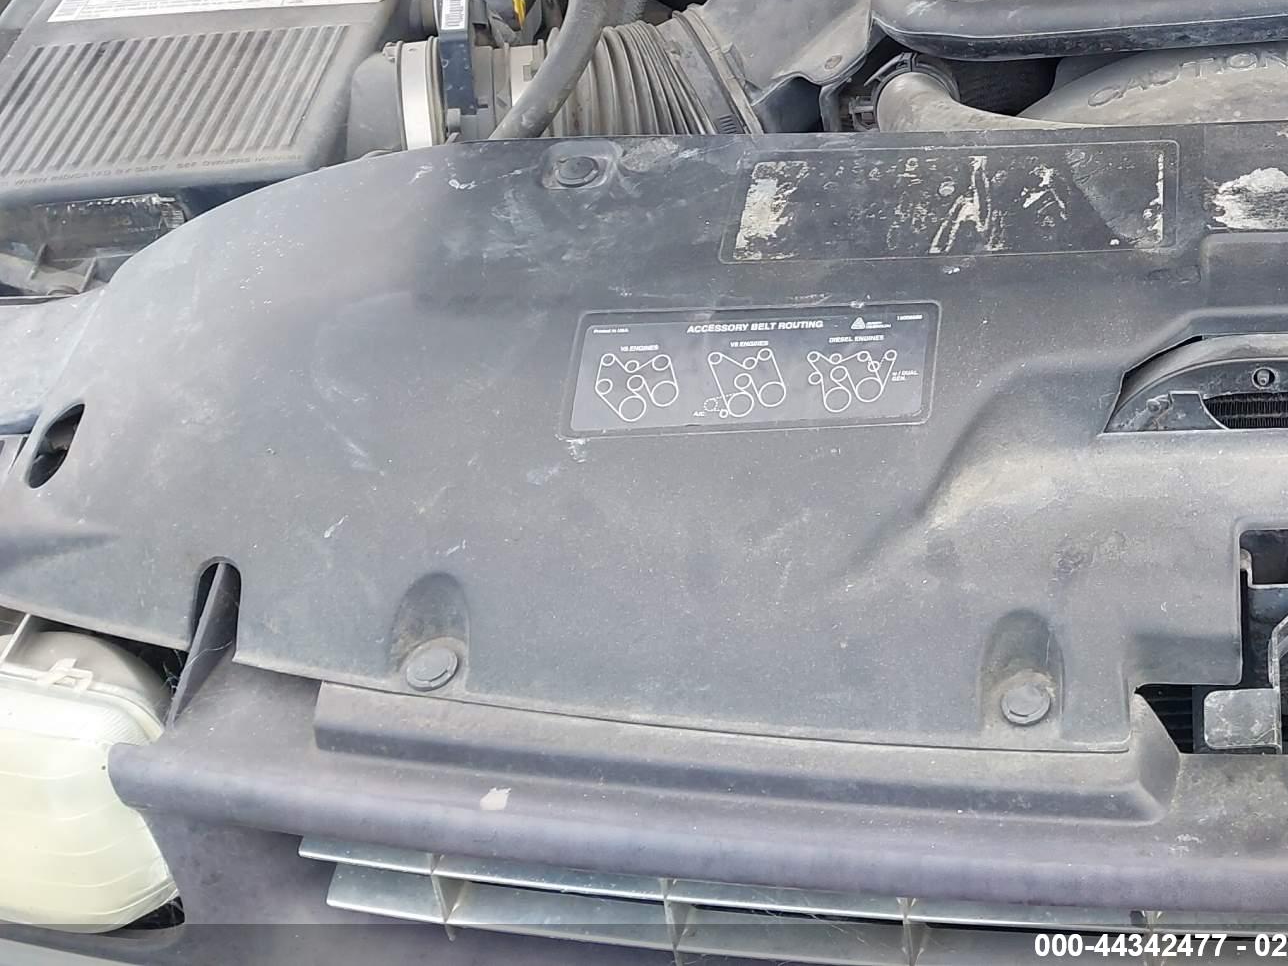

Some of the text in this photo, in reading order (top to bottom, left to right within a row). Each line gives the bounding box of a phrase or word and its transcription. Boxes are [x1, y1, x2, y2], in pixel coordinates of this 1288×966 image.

[686, 320, 824, 334] ACCESSORY BELT ROUTING
